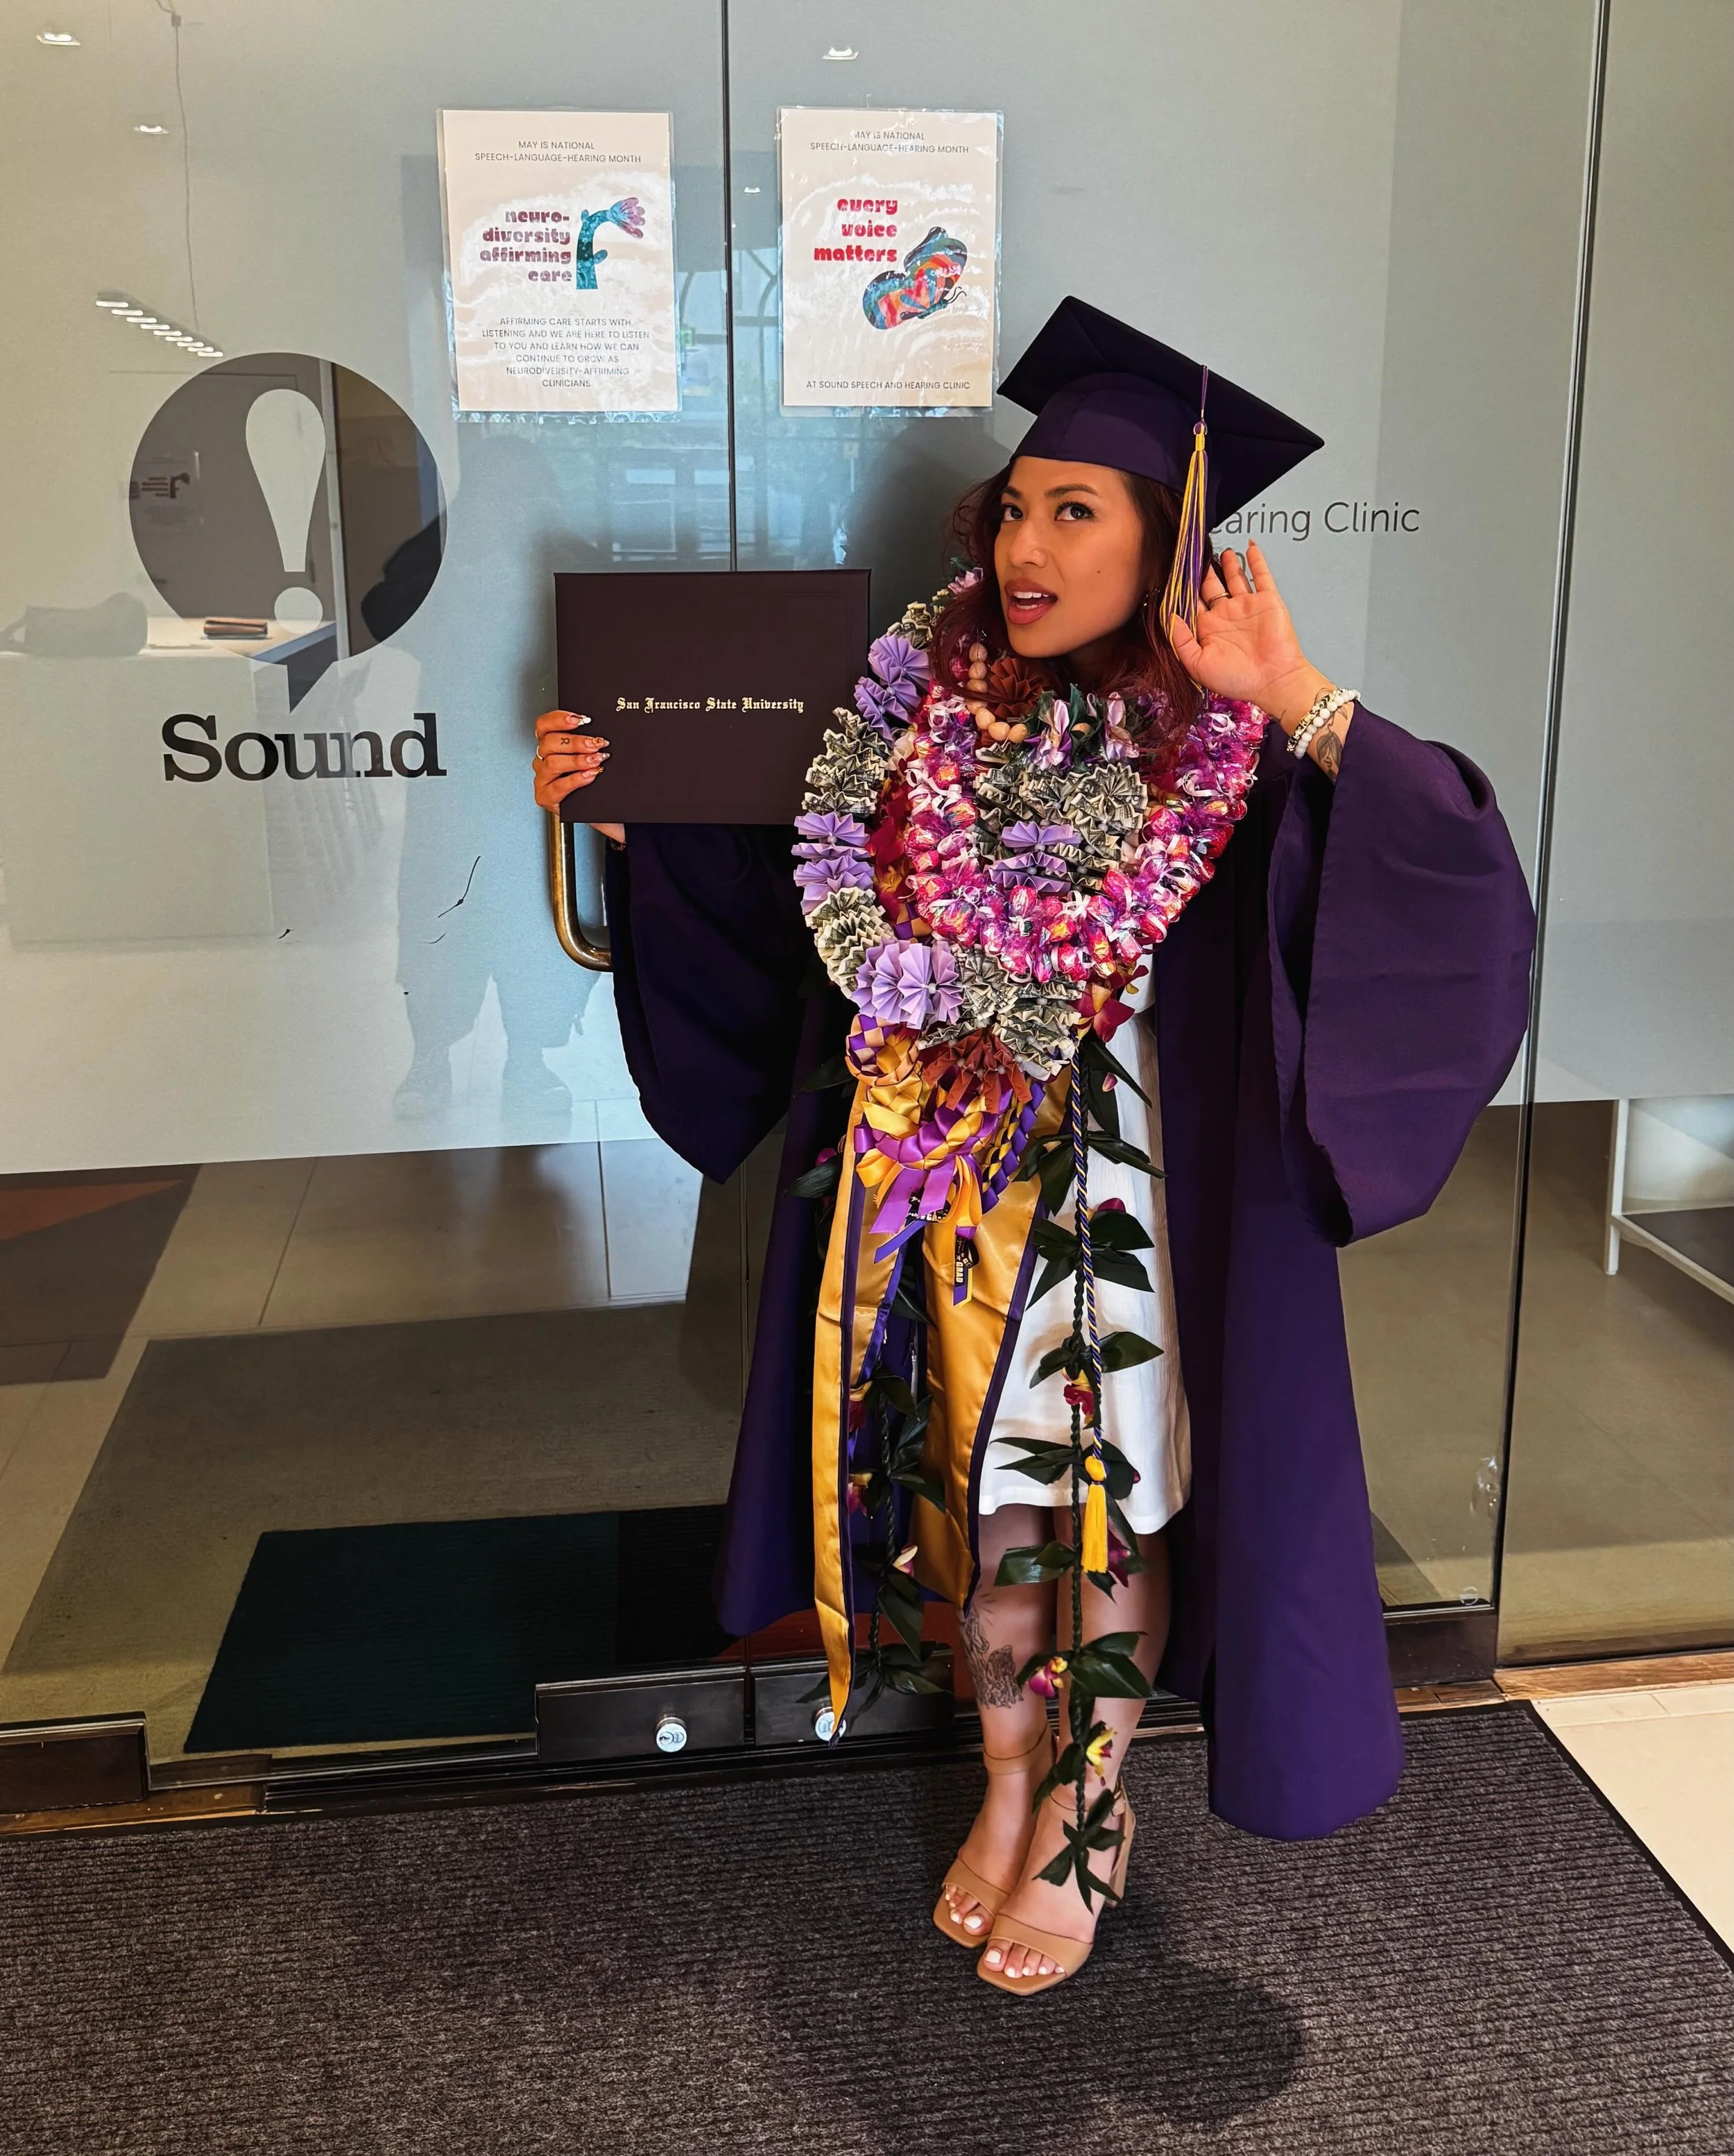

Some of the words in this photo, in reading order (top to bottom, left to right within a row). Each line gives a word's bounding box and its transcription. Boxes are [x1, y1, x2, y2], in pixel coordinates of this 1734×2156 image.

[883, 132, 925, 140] NATIONAL
[518, 141, 538, 149] MAY
[551, 142, 595, 150] NATIONAL
[810, 142, 935, 153] SPEECH-LANGUAGE-HEARING
[475, 153, 606, 162] SPEECH-LANGUAGE-HEARING
[608, 155, 641, 163] MONTH
[837, 198, 898, 215] every
[505, 211, 569, 223] neuro-
[841, 219, 898, 237] voice
[482, 227, 571, 246] diversity
[479, 246, 572, 264] affirming
[814, 244, 898, 262] matters
[528, 271, 572, 282] care
[499, 317, 547, 325] AFFIRMING
[549, 318, 572, 326] CARE
[574, 318, 607, 326] STARTS
[482, 330, 526, 338] LISTENING
[529, 330, 547, 338] AND
[566, 330, 581, 339] ARE
[563, 354, 575, 363] TO
[819, 381, 849, 389] SOUND
[851, 381, 883, 389] SPEECH
[904, 382, 941, 390] HEARING
[943, 382, 970, 390] CLINIC
[1210, 503, 1312, 542] aring
[1324, 502, 1420, 533] Clinic
[616, 697, 639, 712] San
[644, 697, 701, 713] Francisco
[705, 697, 737, 712] State
[741, 697, 805, 713] University
[162, 712, 447, 782] Sound
